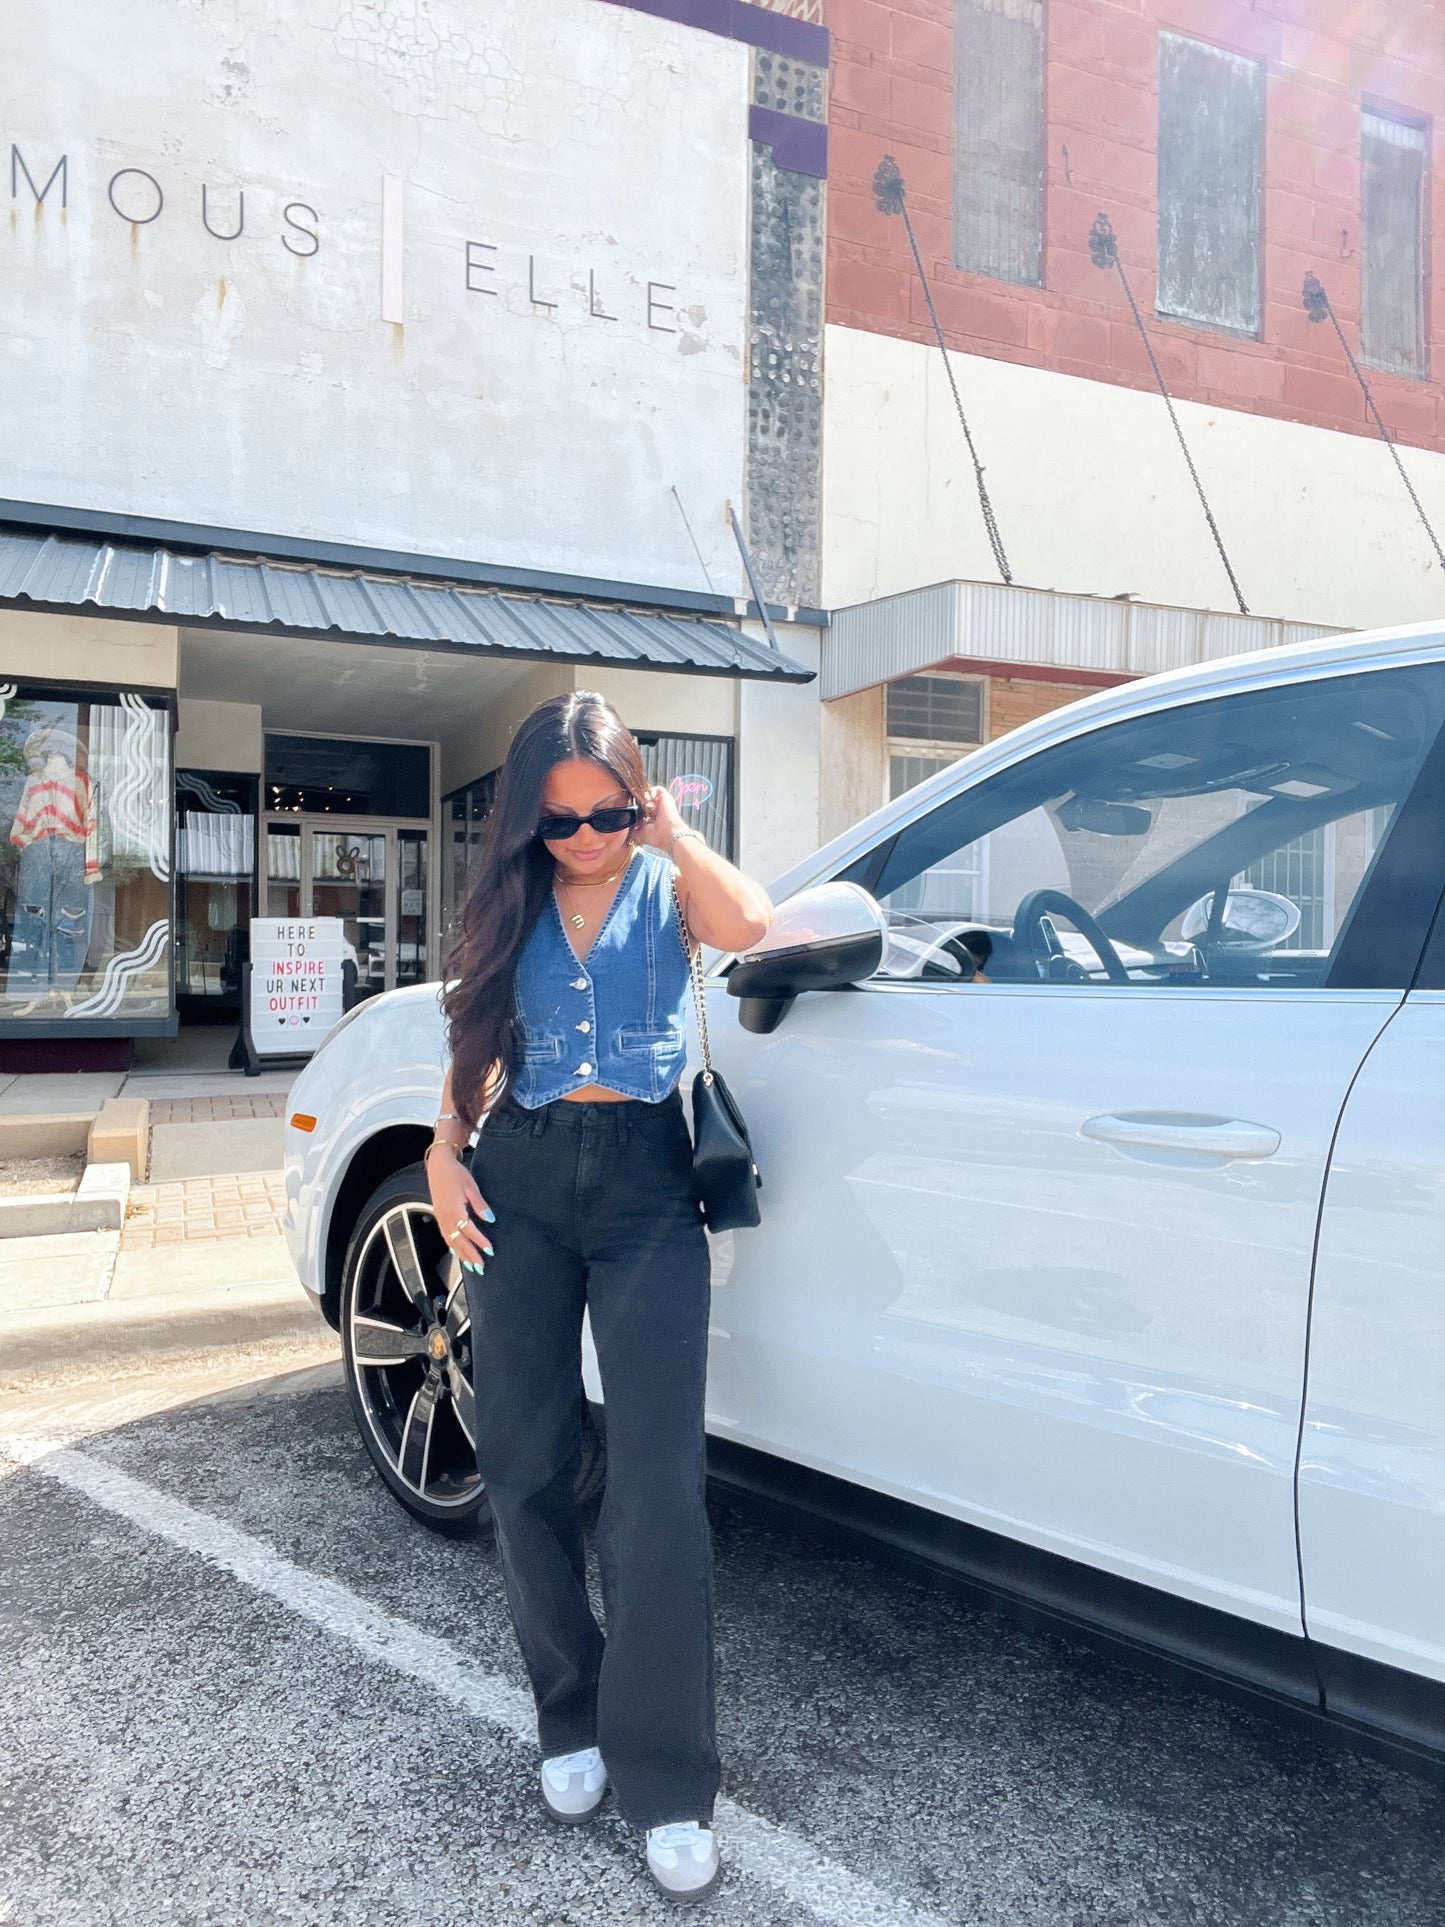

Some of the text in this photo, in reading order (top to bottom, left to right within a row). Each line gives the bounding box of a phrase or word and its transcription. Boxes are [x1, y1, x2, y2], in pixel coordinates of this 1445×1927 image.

[11, 142, 676, 333] MOUS ELLE
[668, 776, 708, 813] Open
[277, 926, 315, 940] HERE
[288, 943, 306, 957] TO
[272, 961, 324, 975] INSPIRE
[266, 978, 326, 993] UR NEXT
[269, 996, 319, 1011] OUTFIT
